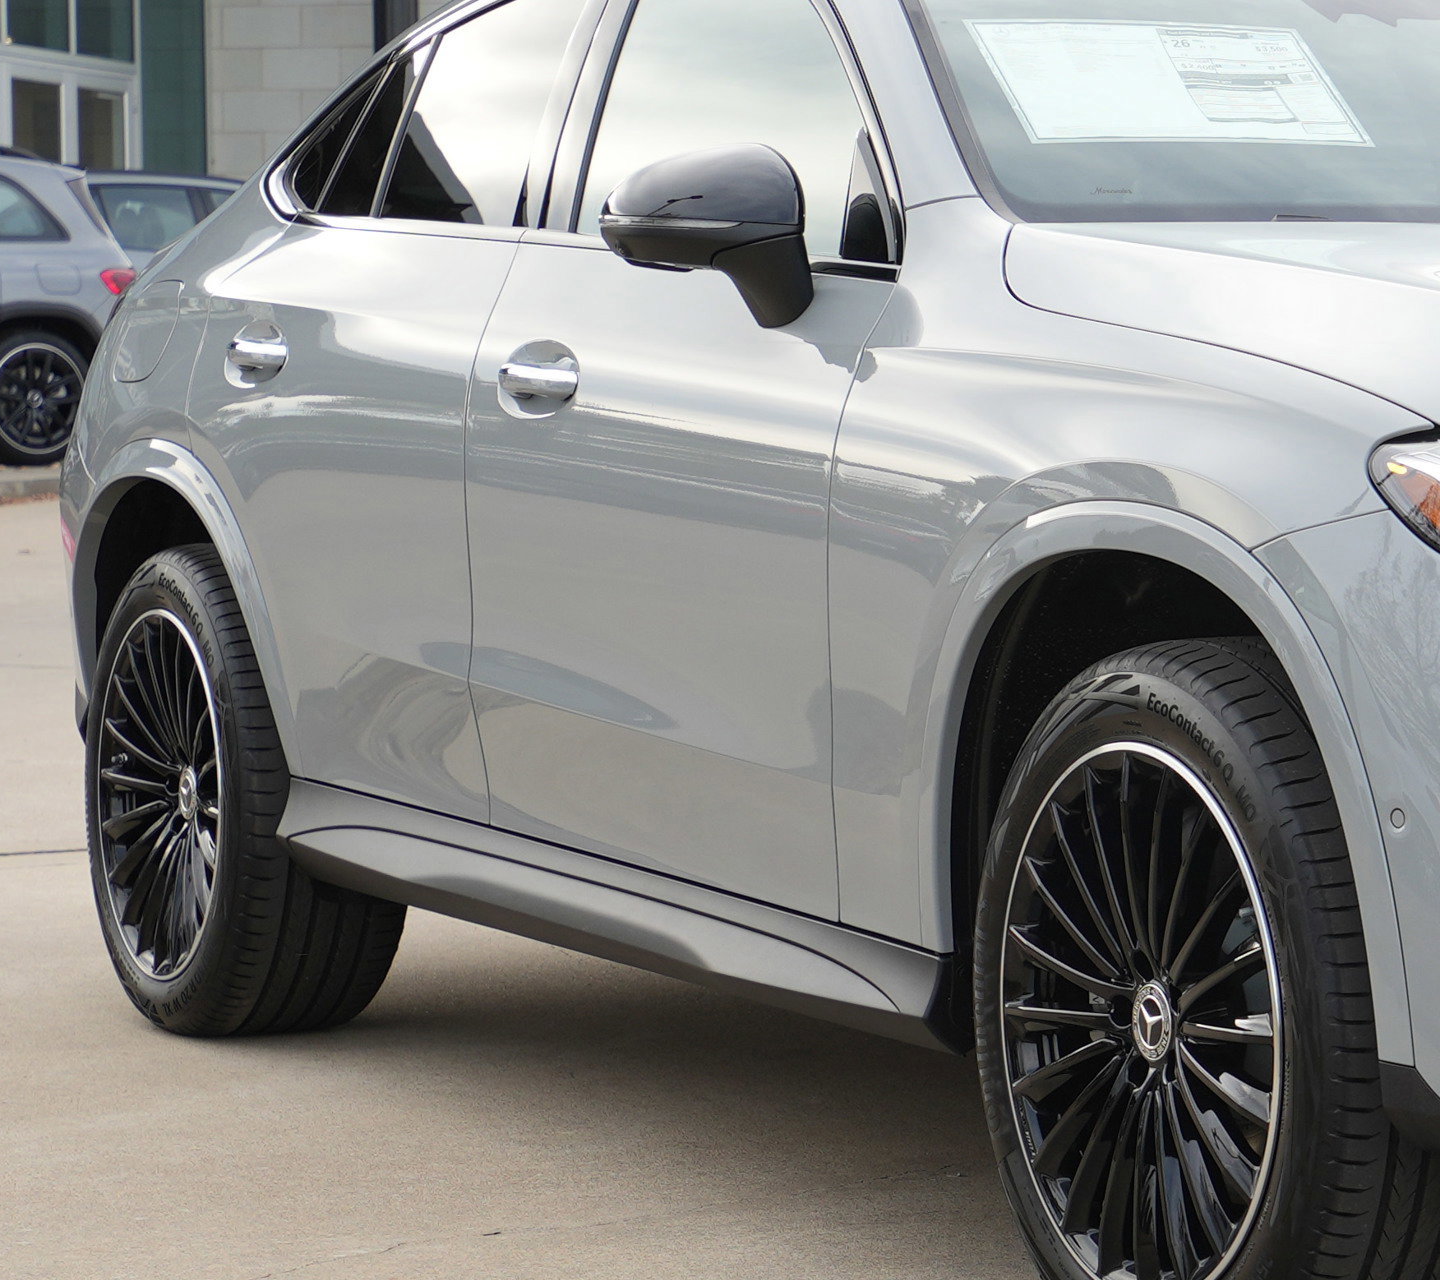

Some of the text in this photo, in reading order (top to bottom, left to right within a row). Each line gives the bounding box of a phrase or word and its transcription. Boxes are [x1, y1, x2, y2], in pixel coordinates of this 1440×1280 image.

[1171, 39, 1191, 48] 26
[158, 572, 194, 618] EcoContact
[1146, 692, 1215, 759] EcoContact
